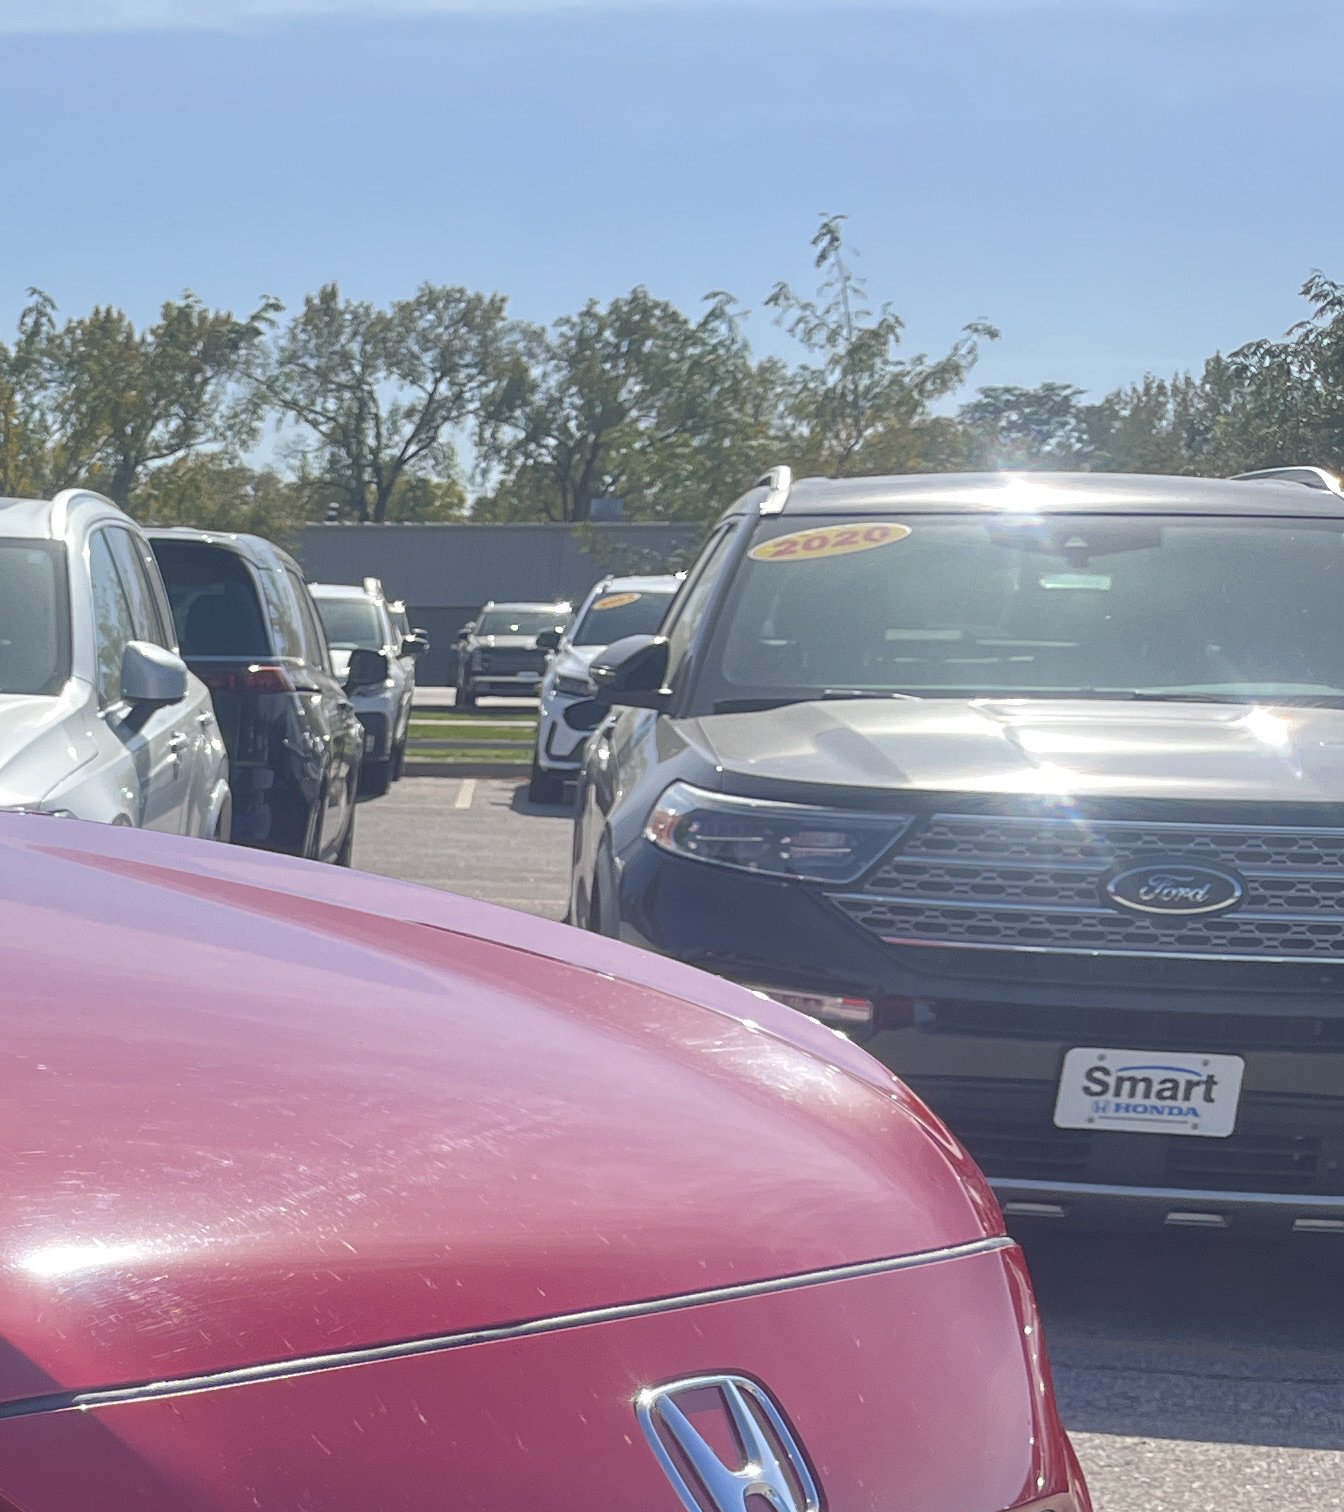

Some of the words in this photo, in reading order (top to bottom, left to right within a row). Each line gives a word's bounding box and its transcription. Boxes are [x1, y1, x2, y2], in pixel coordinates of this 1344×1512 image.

[770, 525, 892, 557] 2020
[1139, 873, 1211, 903] Ford
[1082, 1066, 1218, 1103] Smart
[1114, 1103, 1200, 1117] HONDA
